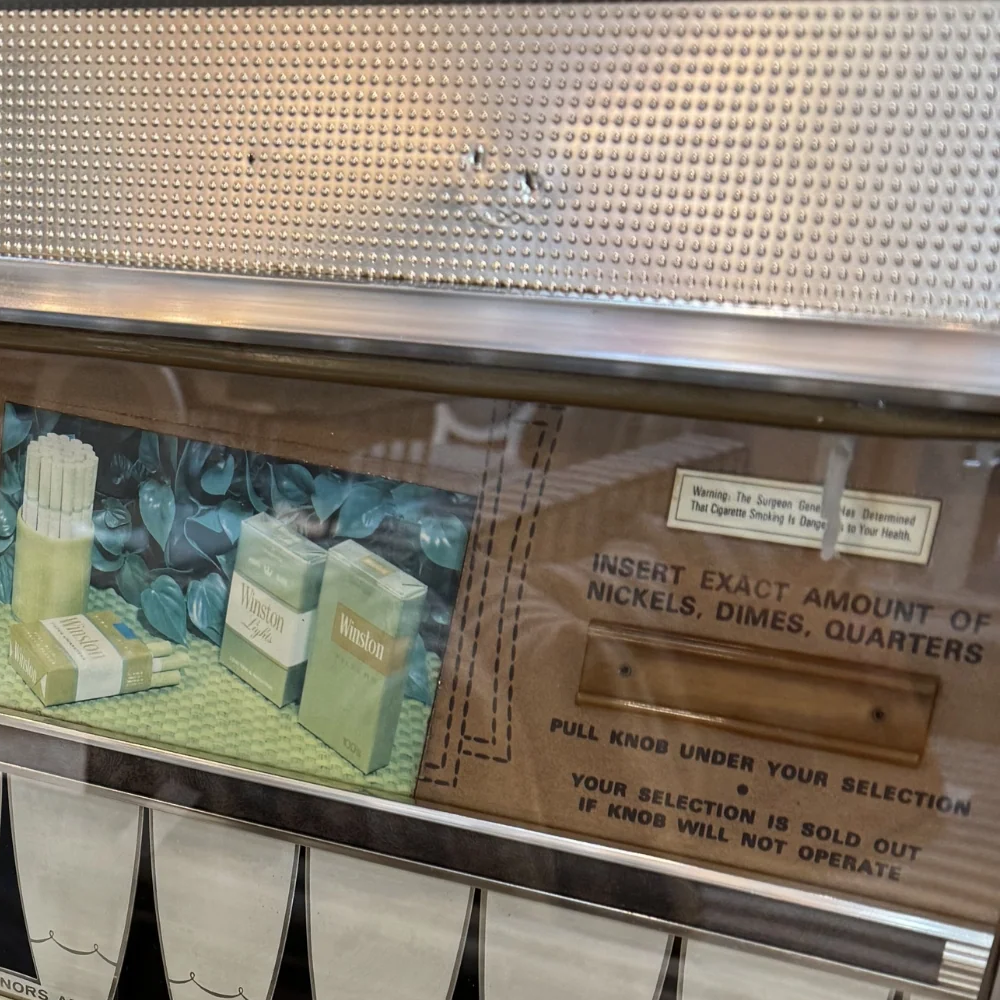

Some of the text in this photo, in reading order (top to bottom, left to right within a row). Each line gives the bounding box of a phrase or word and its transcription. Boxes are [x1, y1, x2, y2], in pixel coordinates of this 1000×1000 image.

[690, 500, 708, 514] That
[710, 503, 747, 520] Cigarette
[749, 508, 786, 527] Smoking
[788, 515, 796, 526] Is
[847, 521, 857, 533] to
[859, 524, 879, 538] Your
[880, 528, 912, 543] Health.
[736, 490, 751, 504] The
[756, 494, 792, 512] Surgeon
[862, 508, 916, 527] Determined
[241, 582, 285, 634] Winston
[592, 552, 992, 636] INSERT EXACT AMOUNT OF
[60, 617, 106, 660] Winston
[241, 618, 273, 644] Lights
[340, 612, 385, 661] Winston
[587, 580, 986, 666] NICKELS, DIMES, QUARTERS
[550, 717, 971, 818] PULL KNOB UNDER YOUR SELECTION
[571, 772, 922, 863] YOUR SELECTION IS SOLD OUT
[578, 796, 902, 882] IF KNOB WILL NOT OPERATE
